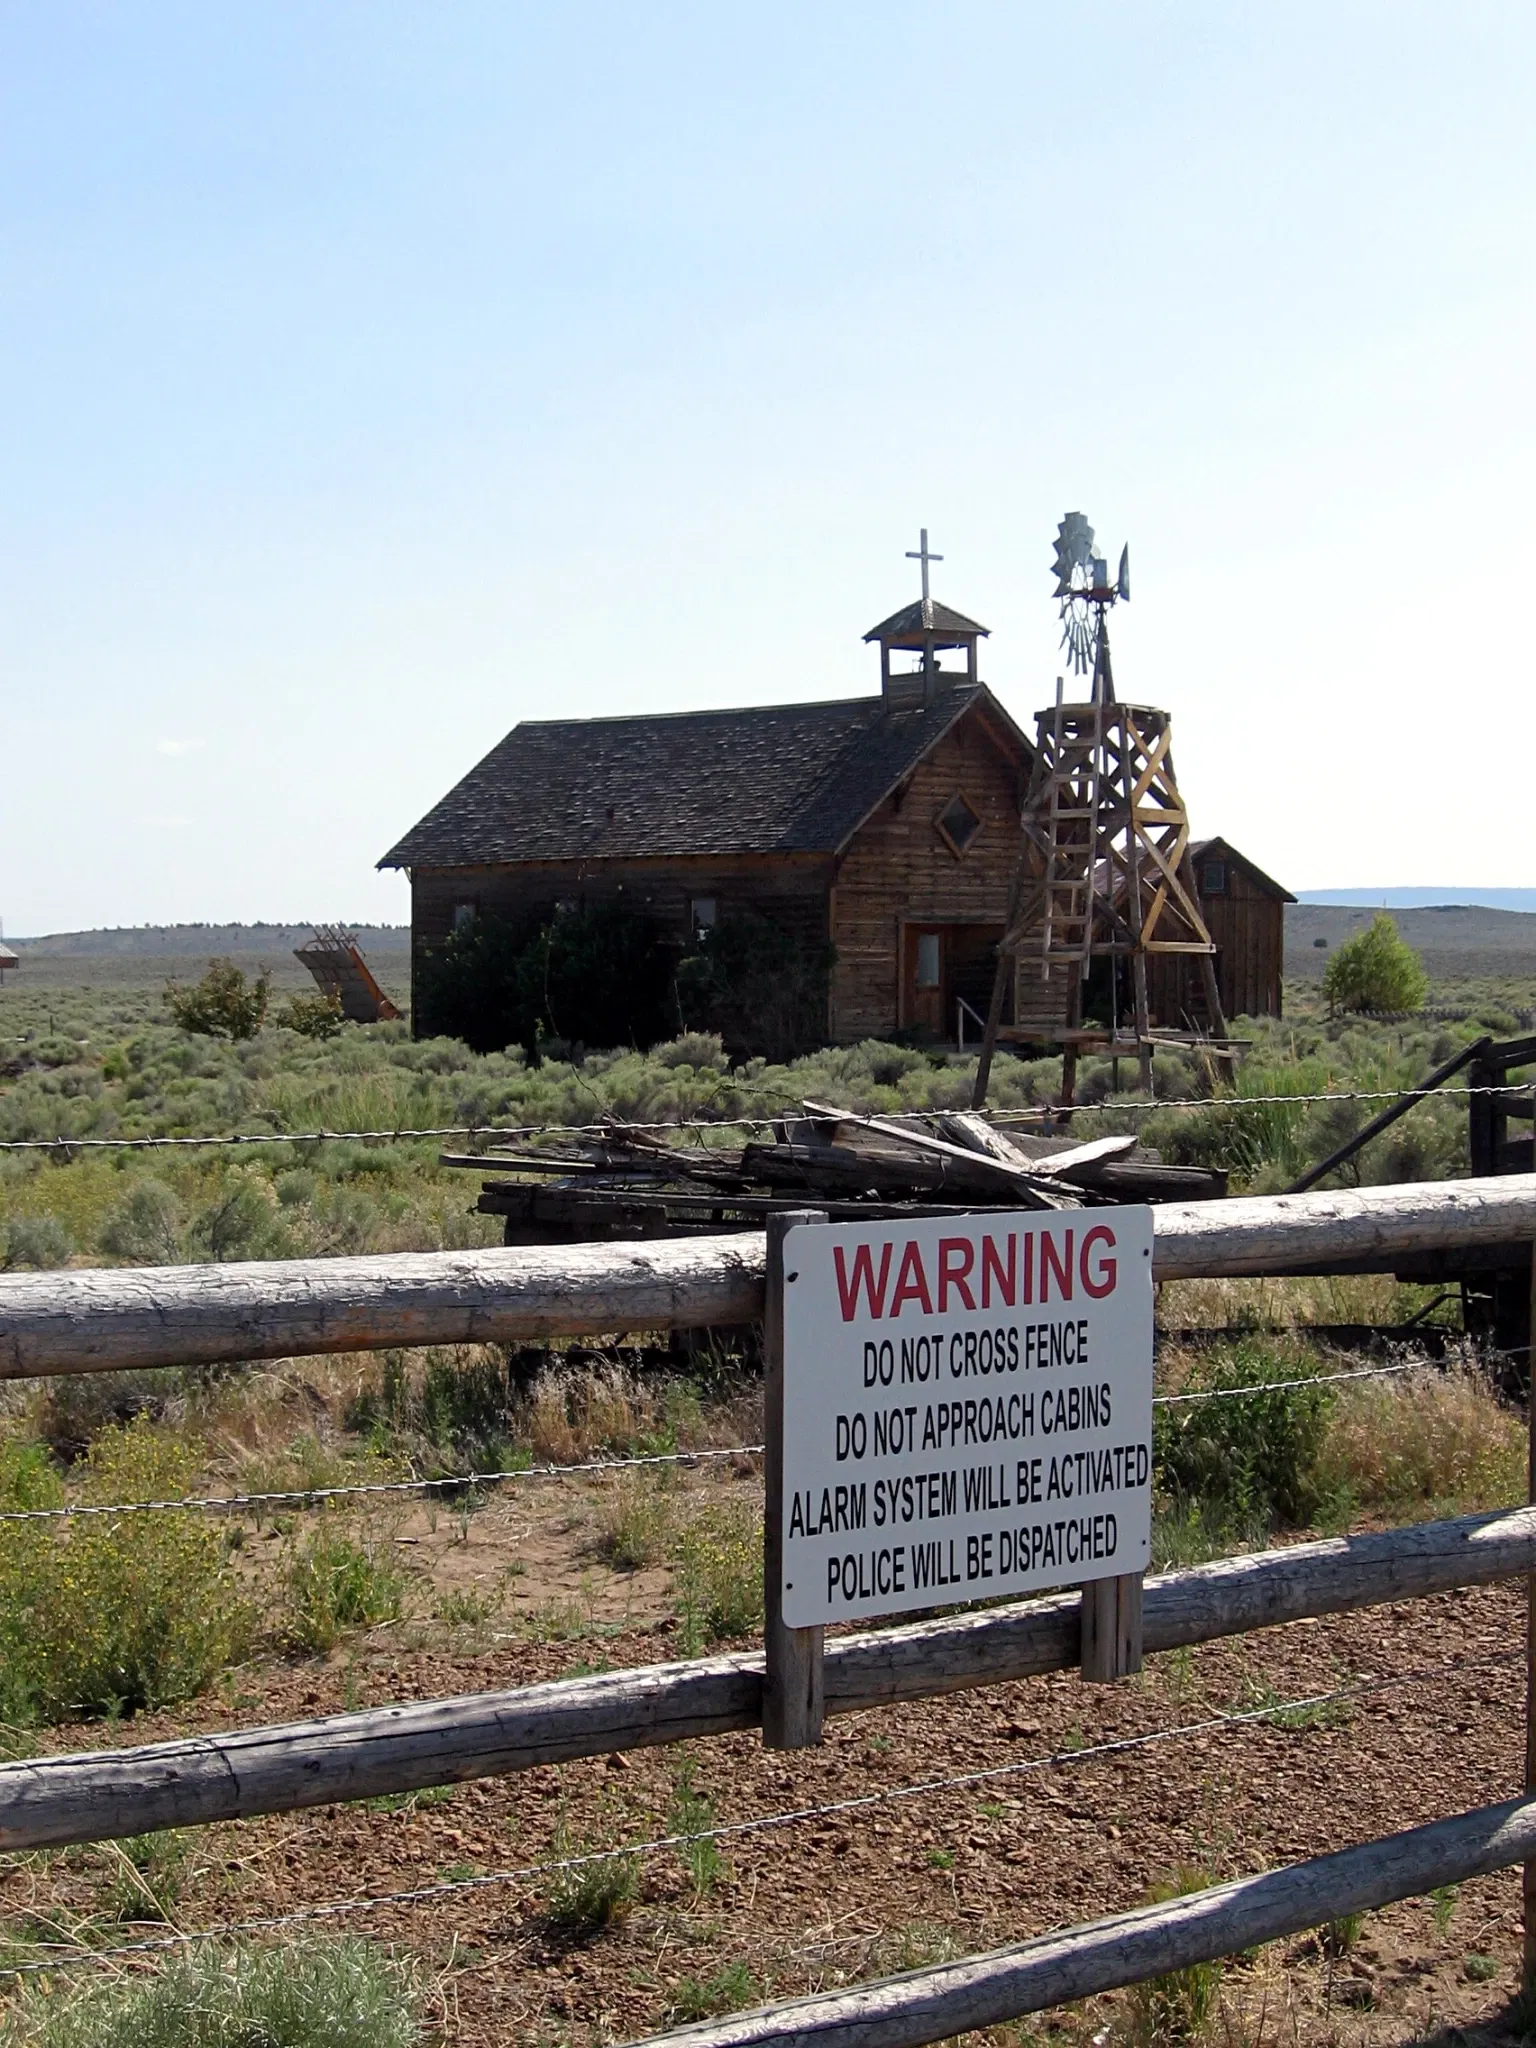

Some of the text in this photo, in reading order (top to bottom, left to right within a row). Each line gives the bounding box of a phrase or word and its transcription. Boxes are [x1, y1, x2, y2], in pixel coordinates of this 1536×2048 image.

[833, 1224, 1117, 1322] WARNING
[863, 1320, 1089, 1388] DO NOT CROSS FENCE
[836, 1383, 1112, 1461] DO NOT APPROACH CABINS
[789, 1444, 1148, 1539] ALARM SYSTEM WILL BE ACTIVATED
[828, 1514, 1118, 1603] POLICE WILL BE DISPATCHED
